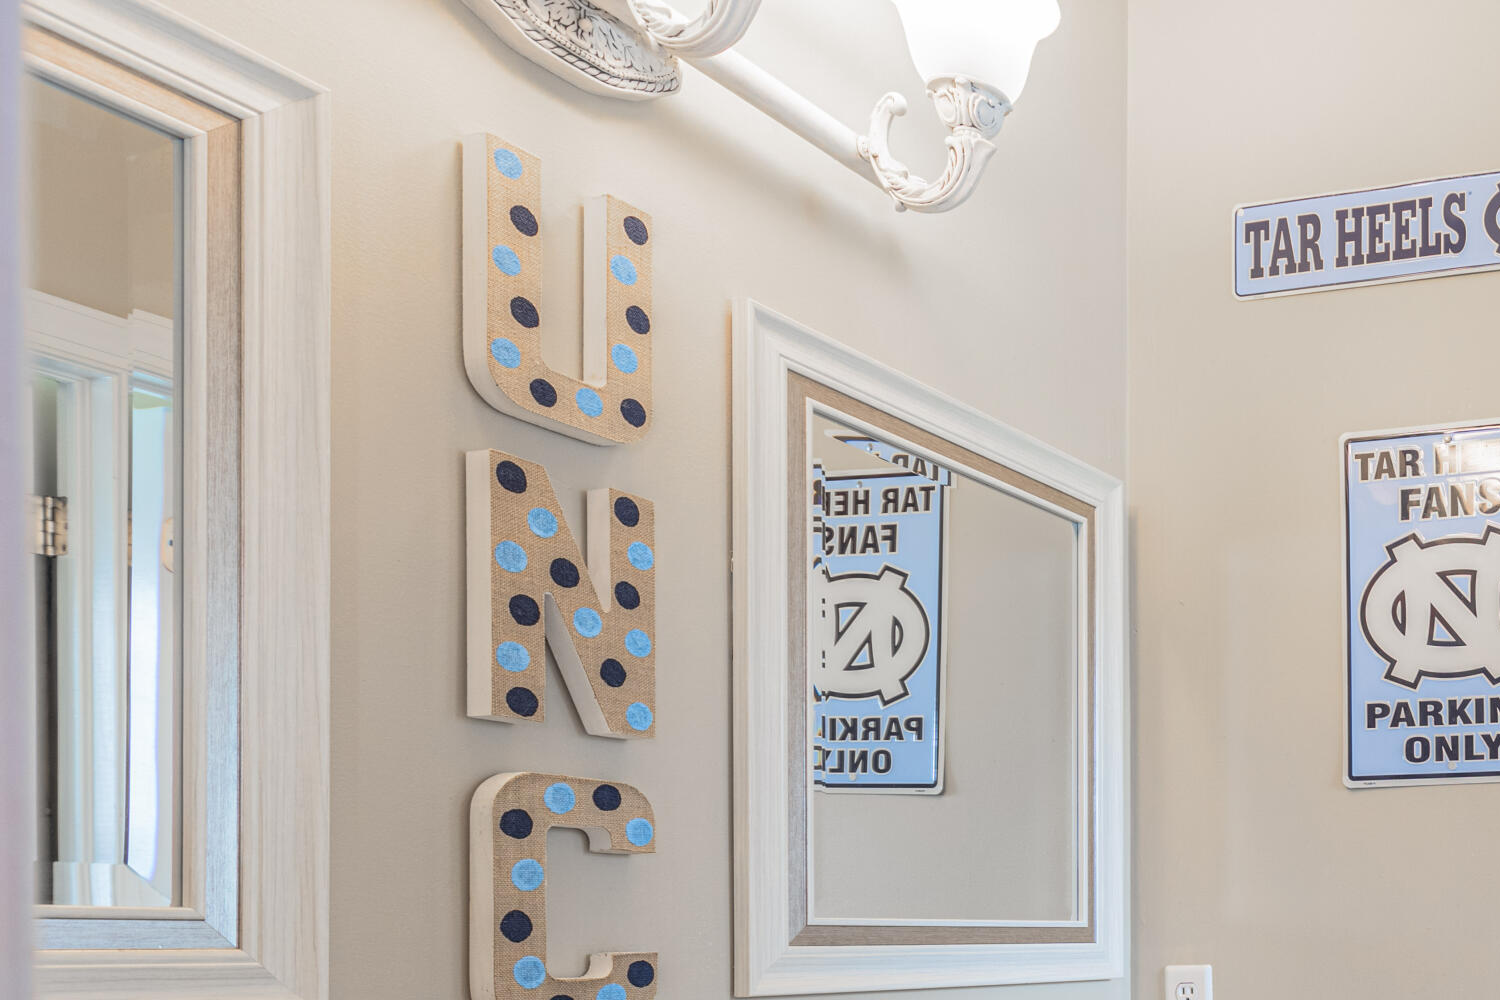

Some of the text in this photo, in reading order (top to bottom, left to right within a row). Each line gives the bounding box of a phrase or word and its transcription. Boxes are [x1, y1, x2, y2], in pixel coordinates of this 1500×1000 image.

[1244, 212, 1323, 279] TAR
[1334, 191, 1467, 268] HEELS
[1354, 448, 1421, 482] TAR
